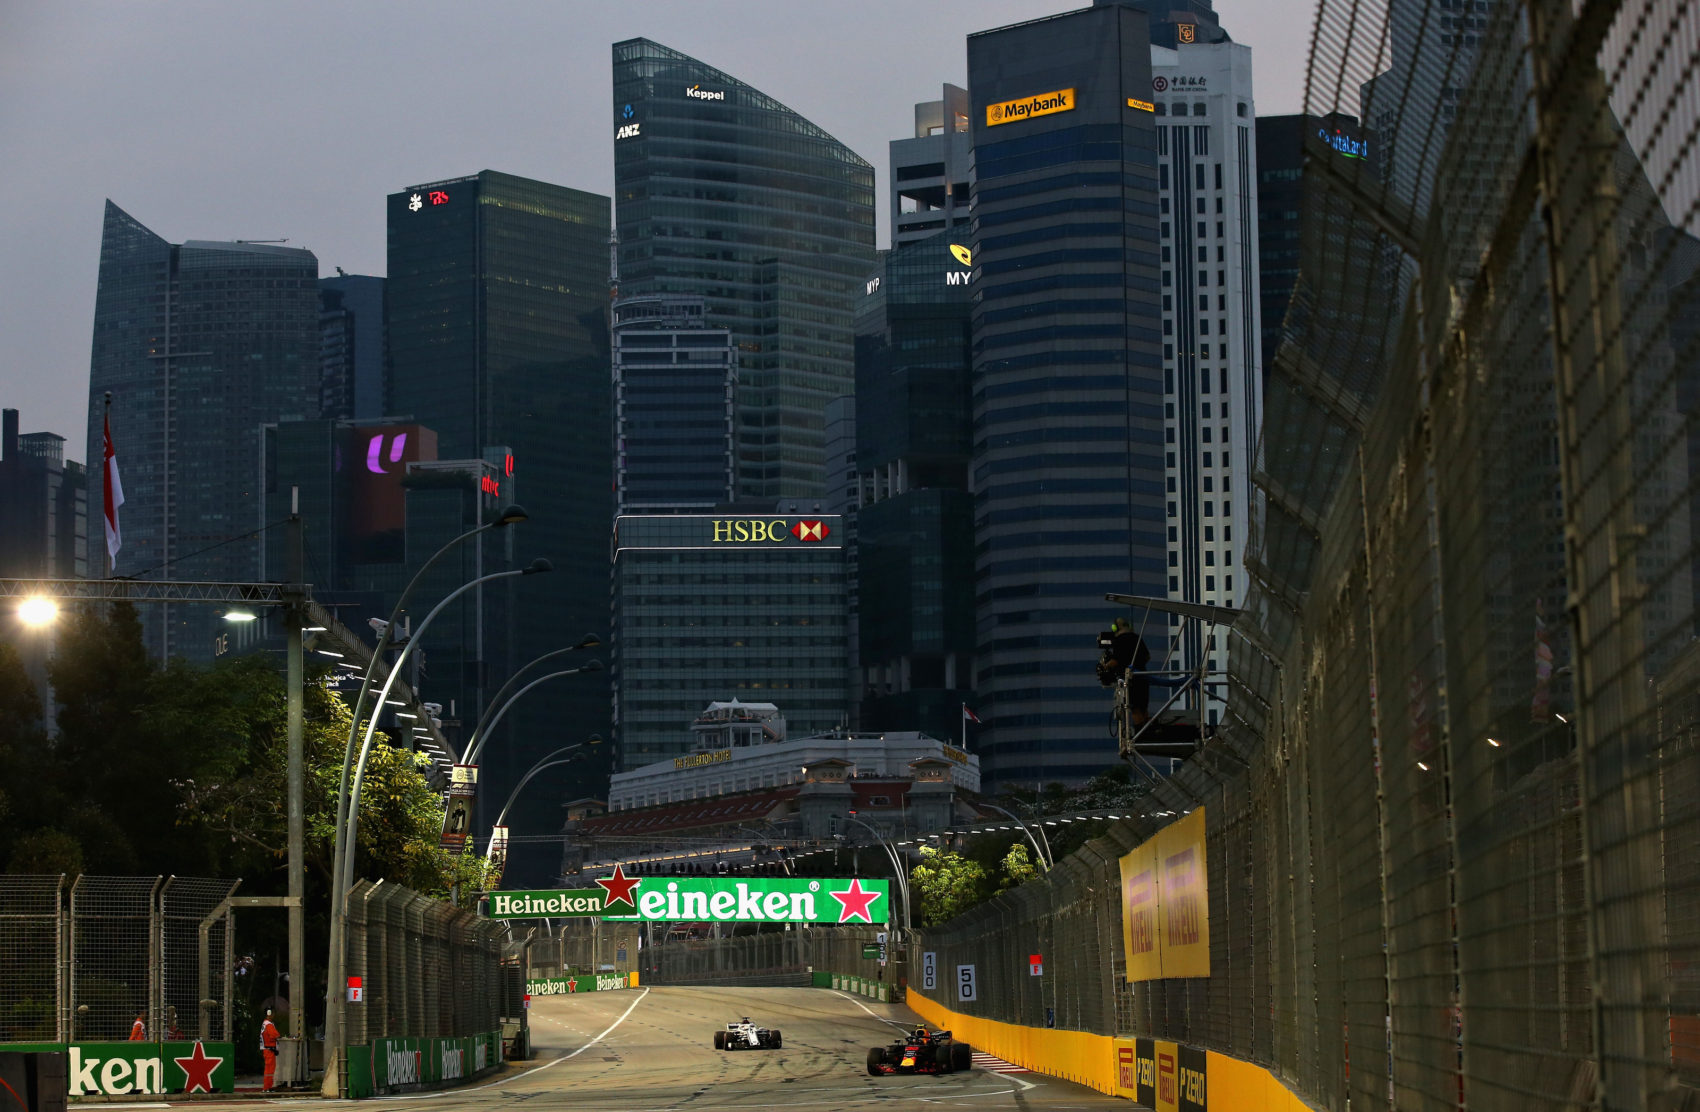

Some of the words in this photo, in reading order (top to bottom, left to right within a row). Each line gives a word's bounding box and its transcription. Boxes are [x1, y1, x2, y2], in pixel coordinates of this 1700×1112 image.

[686, 87, 724, 100] Keppel
[1004, 93, 1066, 118] Maybank
[616, 123, 640, 139] ANZ
[866, 277, 880, 295] MYP
[712, 520, 787, 542] HSBC
[215, 633, 229, 657] OUE
[674, 758, 684, 768] THE
[685, 753, 713, 768] FULLERTON
[713, 749, 732, 762] HOTEL
[494, 894, 601, 914] Heineken
[1165, 847, 1200, 947] PIRELLI
[1129, 869, 1153, 955] PIRELLI
[926, 954, 934, 987] 100
[1033, 965, 1039, 974] F
[353, 989, 359, 1000] F
[596, 974, 624, 991] Heineken
[961, 968, 972, 998] 50
[69, 1047, 167, 1095] ken
[387, 1040, 417, 1085] Heineken
[1118, 1048, 1134, 1089] PIRELLI
[1136, 1057, 1140, 1084] P
[1141, 1058, 1154, 1088] ZERO
[1159, 1053, 1174, 1105] PIRELLI
[1180, 1067, 1185, 1097] P
[1186, 1069, 1205, 1106] ZERO
